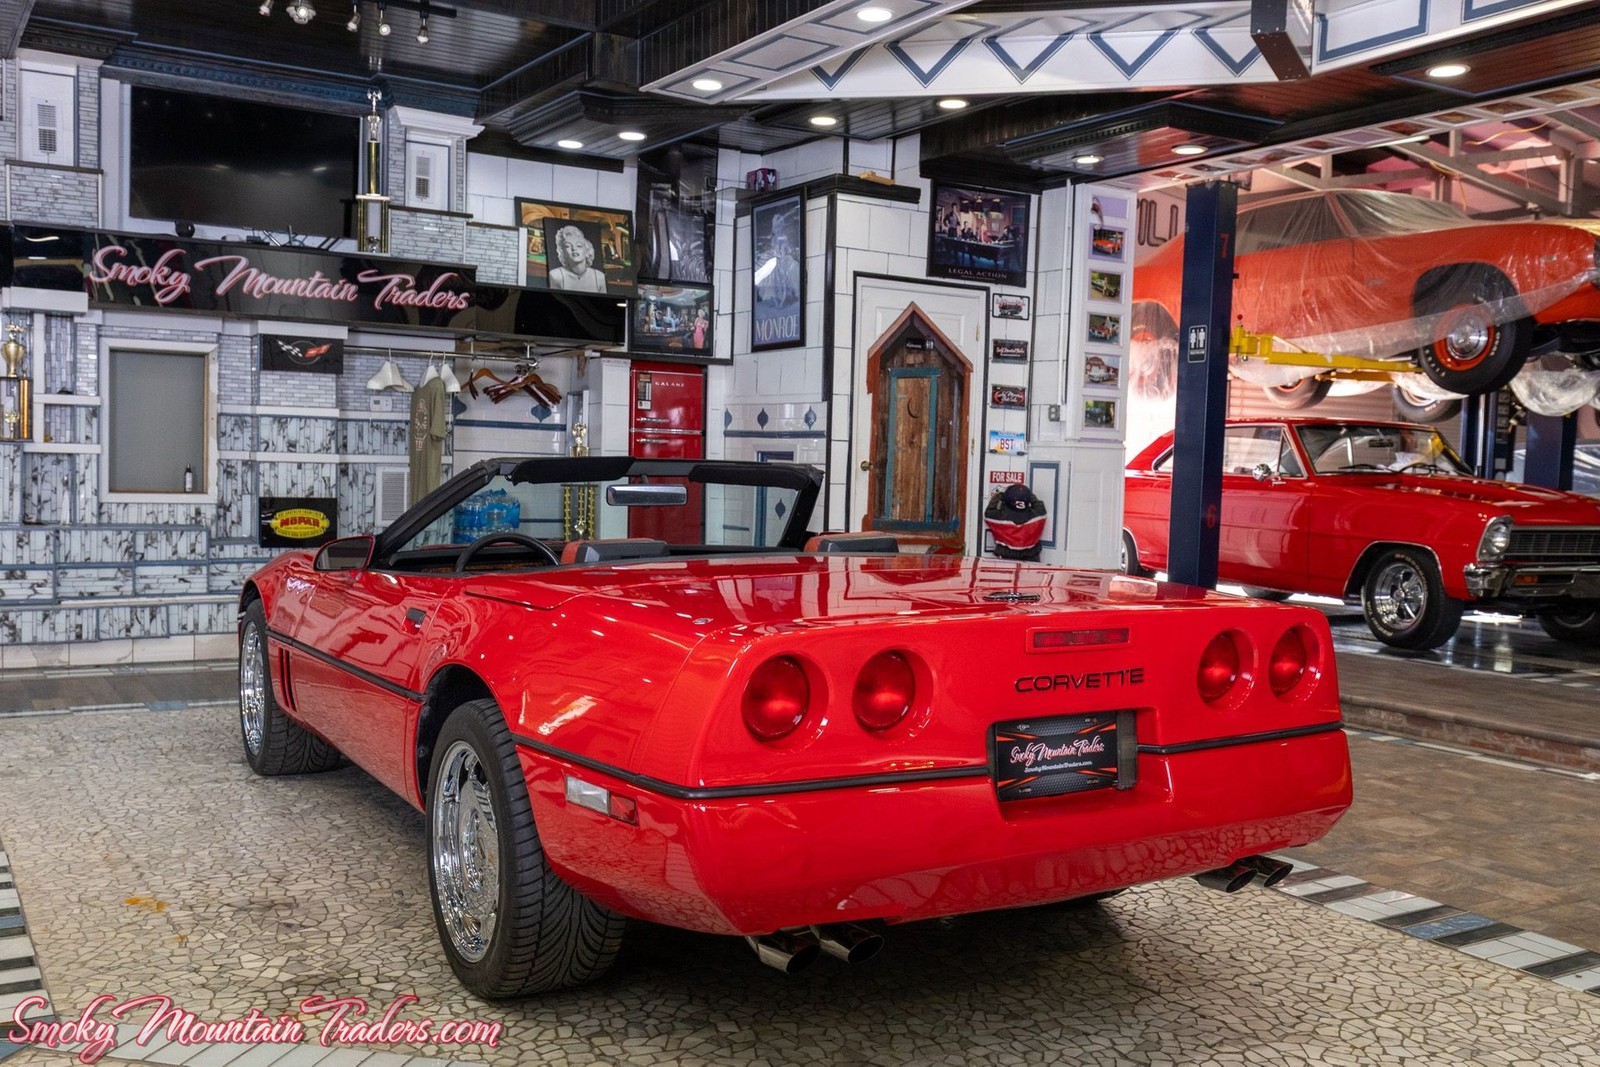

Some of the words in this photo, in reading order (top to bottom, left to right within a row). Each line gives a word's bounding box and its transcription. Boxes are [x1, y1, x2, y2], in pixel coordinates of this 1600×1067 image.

[1220, 232, 1230, 258] 7
[89, 245, 191, 303] Smoky
[194, 255, 358, 301] Mountain
[357, 269, 470, 310] Traders
[948, 267, 973, 276] LEGAL
[976, 271, 1008, 279] ACTION
[755, 314, 800, 341] MONROE
[1000, 438, 1015, 450] BST
[992, 472, 1005, 483] FOR
[1006, 472, 1023, 483] SALE
[1015, 501, 1026, 509] 3
[1207, 503, 1217, 528] 6
[1014, 667, 1145, 693] CORVETTE
[1010, 741, 1036, 767] Smoky
[1031, 742, 1076, 761] Mountain
[1073, 735, 1105, 757] Traders
